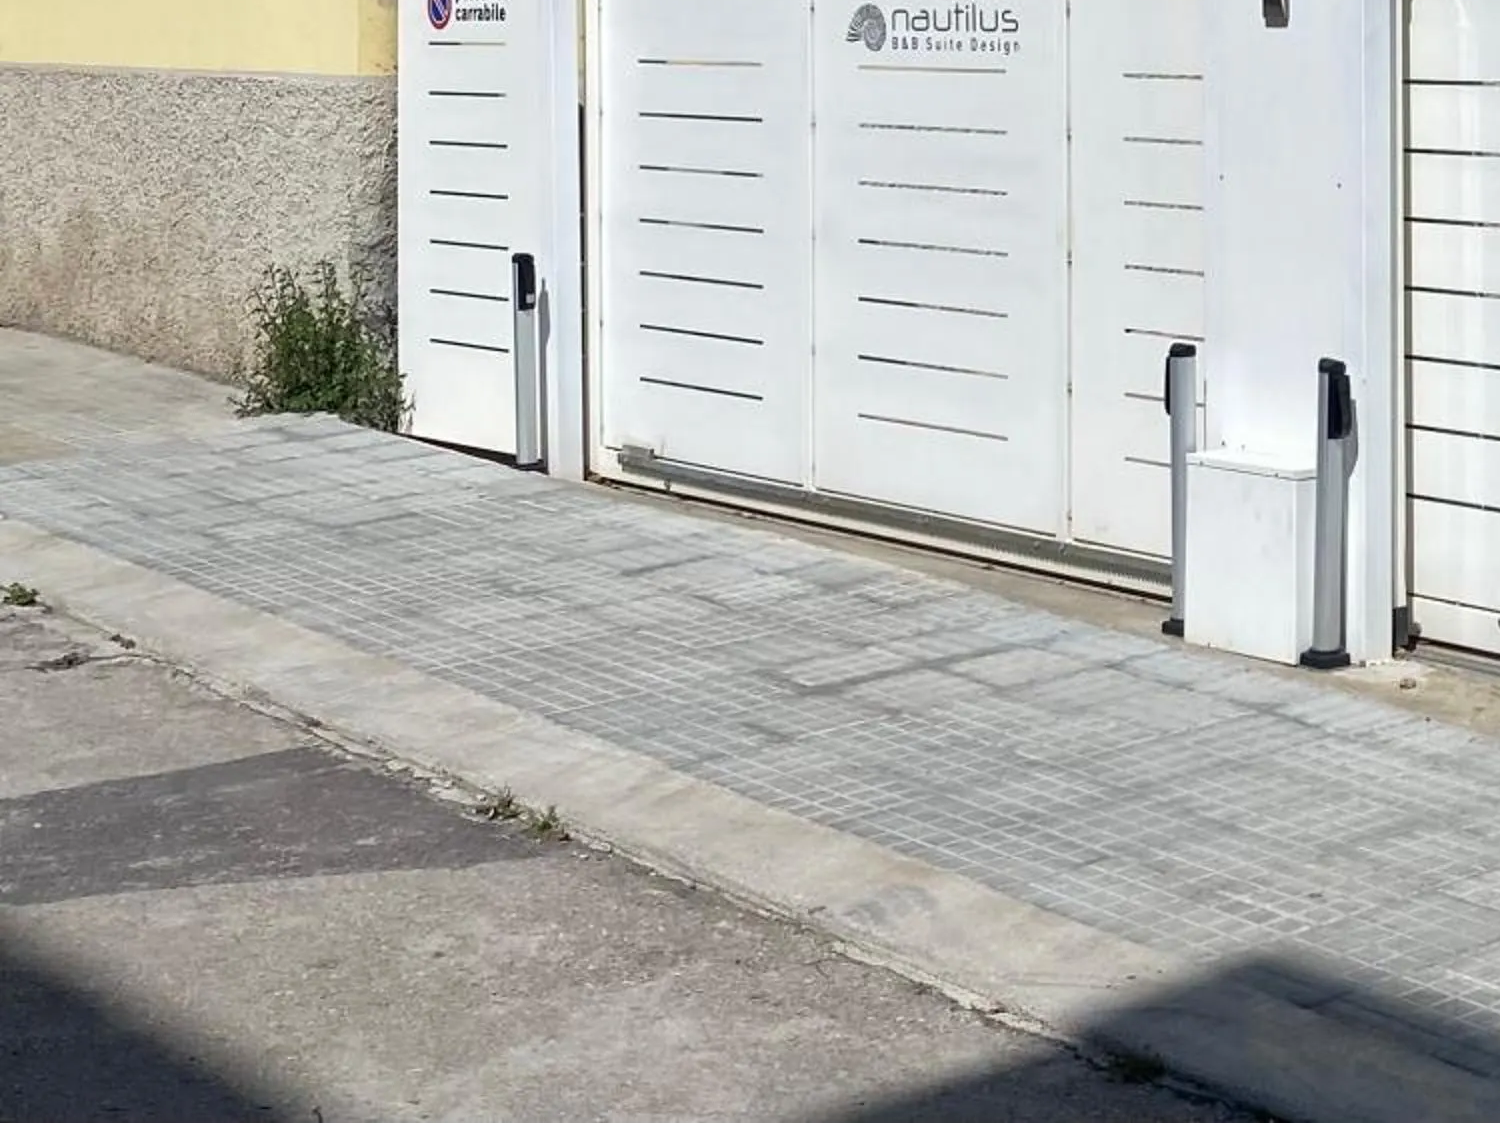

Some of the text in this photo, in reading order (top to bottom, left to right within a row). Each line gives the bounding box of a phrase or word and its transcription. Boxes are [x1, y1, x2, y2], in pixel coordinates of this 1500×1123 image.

[455, 4, 506, 21] carrabile
[891, 3, 1019, 32] nautilus
[891, 36, 1020, 55] B&B Suite Design
